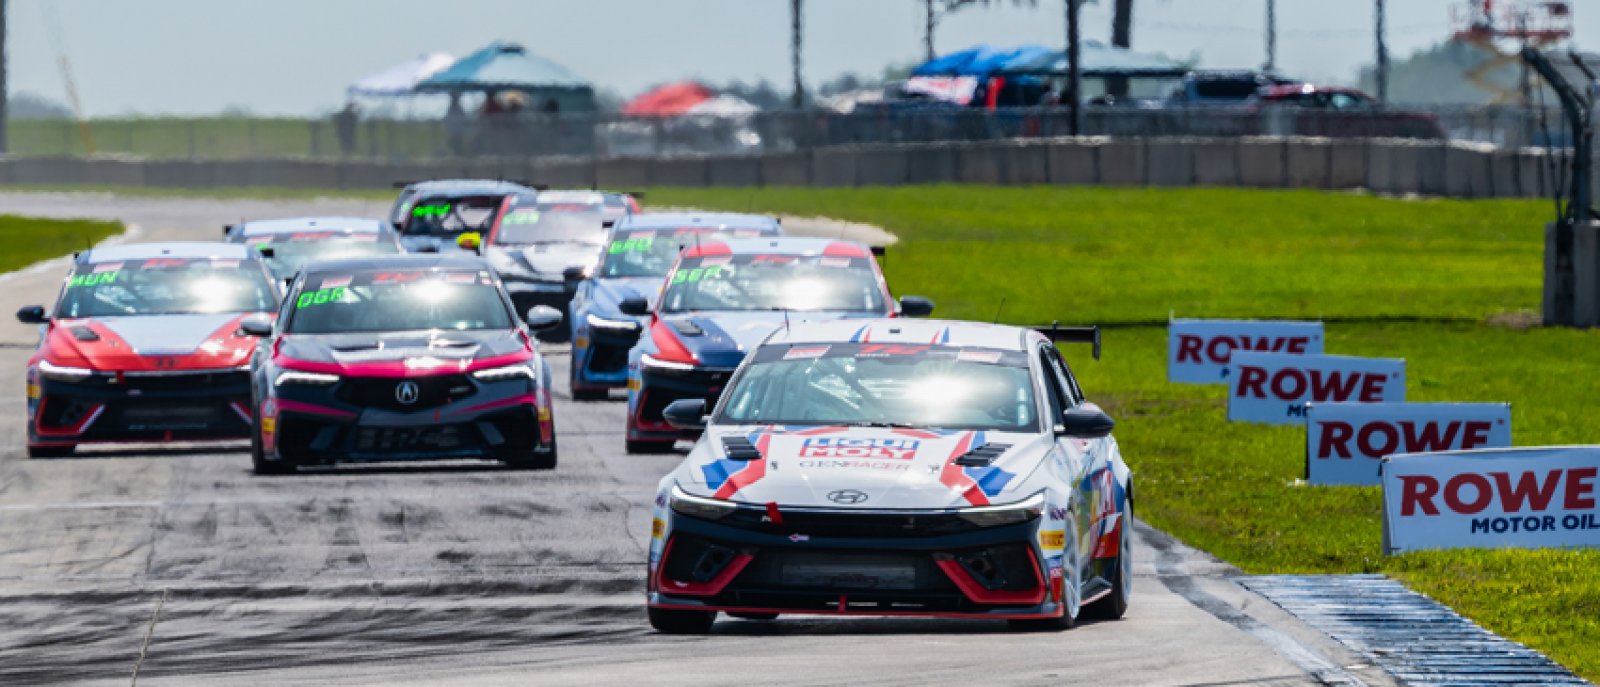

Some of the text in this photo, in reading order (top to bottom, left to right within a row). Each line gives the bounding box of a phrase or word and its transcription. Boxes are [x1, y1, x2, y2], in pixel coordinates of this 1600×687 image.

[1236, 364, 1388, 402] ROWE
[800, 447, 916, 459] MOLY
[803, 438, 920, 449] LIQUI
[1316, 420, 1492, 459] ROWE
[1395, 467, 1597, 516] ROWE
[1471, 515, 1556, 534] MOTOR
